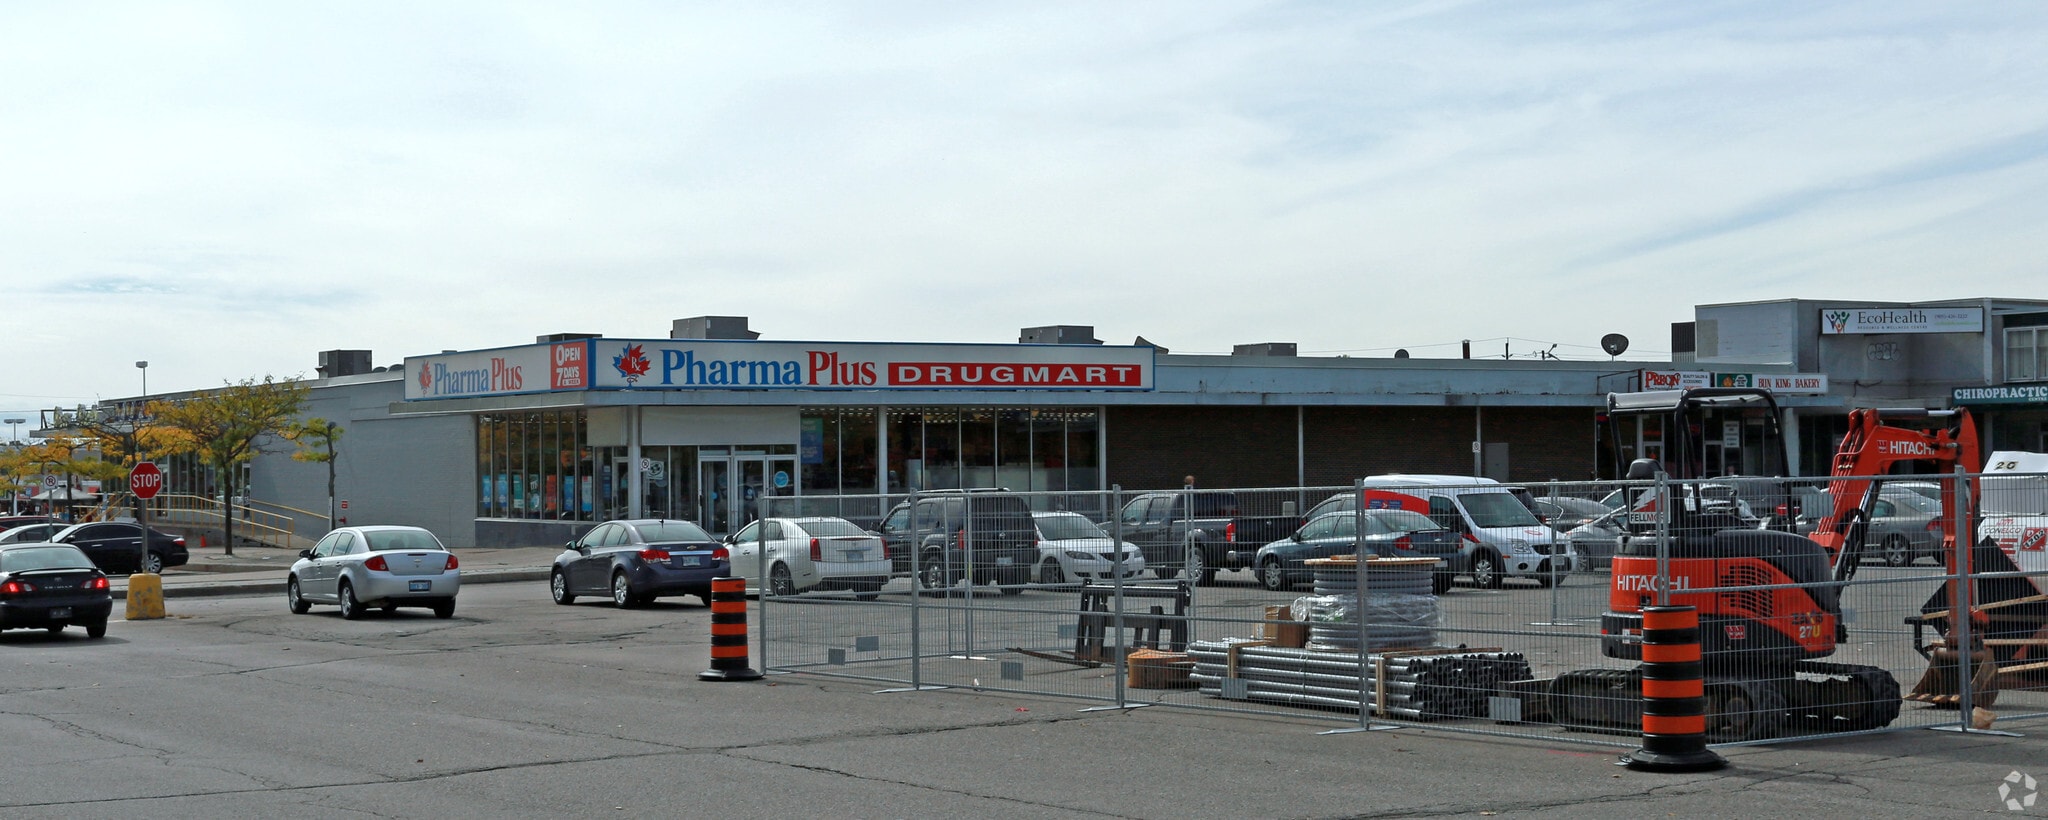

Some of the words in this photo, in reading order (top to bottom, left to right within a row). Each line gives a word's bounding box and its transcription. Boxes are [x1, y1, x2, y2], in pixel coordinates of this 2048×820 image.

[1858, 310, 1927, 324] EcoHealth
[556, 344, 580, 366] OPEN
[434, 362, 489, 395] Pharma
[491, 357, 523, 391] Plus
[556, 367, 564, 386] 7
[563, 366, 580, 379] DAYS
[660, 349, 802, 386] Pharma
[805, 350, 877, 386] Plus
[898, 365, 1132, 383] DRUGMART
[1758, 377, 1771, 388] BUN
[1775, 377, 1791, 388] KING
[1795, 377, 1820, 388] BAKERY
[1954, 386, 2048, 400] CHIROPRACTIC
[132, 473, 160, 488] STOP
